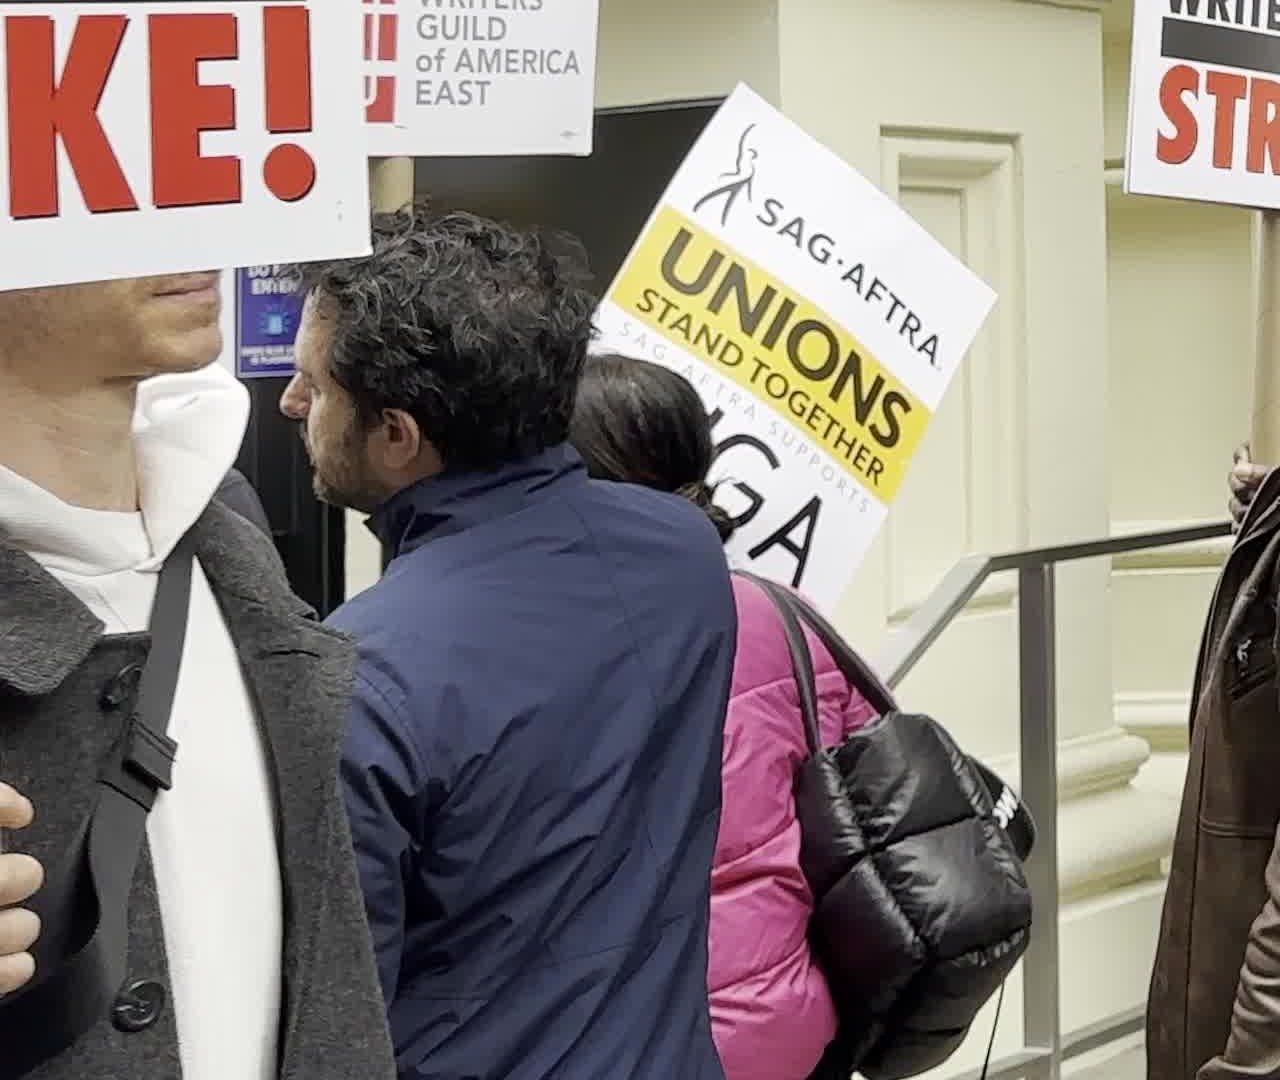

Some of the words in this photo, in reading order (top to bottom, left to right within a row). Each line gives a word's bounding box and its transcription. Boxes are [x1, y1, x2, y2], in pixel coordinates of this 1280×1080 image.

[415, 48, 447, 73] of
[453, 47, 581, 75] AMERICA
[416, 13, 507, 42] GUILD
[3, 4, 317, 220] KE!
[415, 79, 491, 107] EAST
[660, 226, 913, 450] UNIONS
[635, 287, 745, 368] STAND
[748, 356, 885, 487] TOGETHER
[767, 421, 871, 514] SUPPORTS
